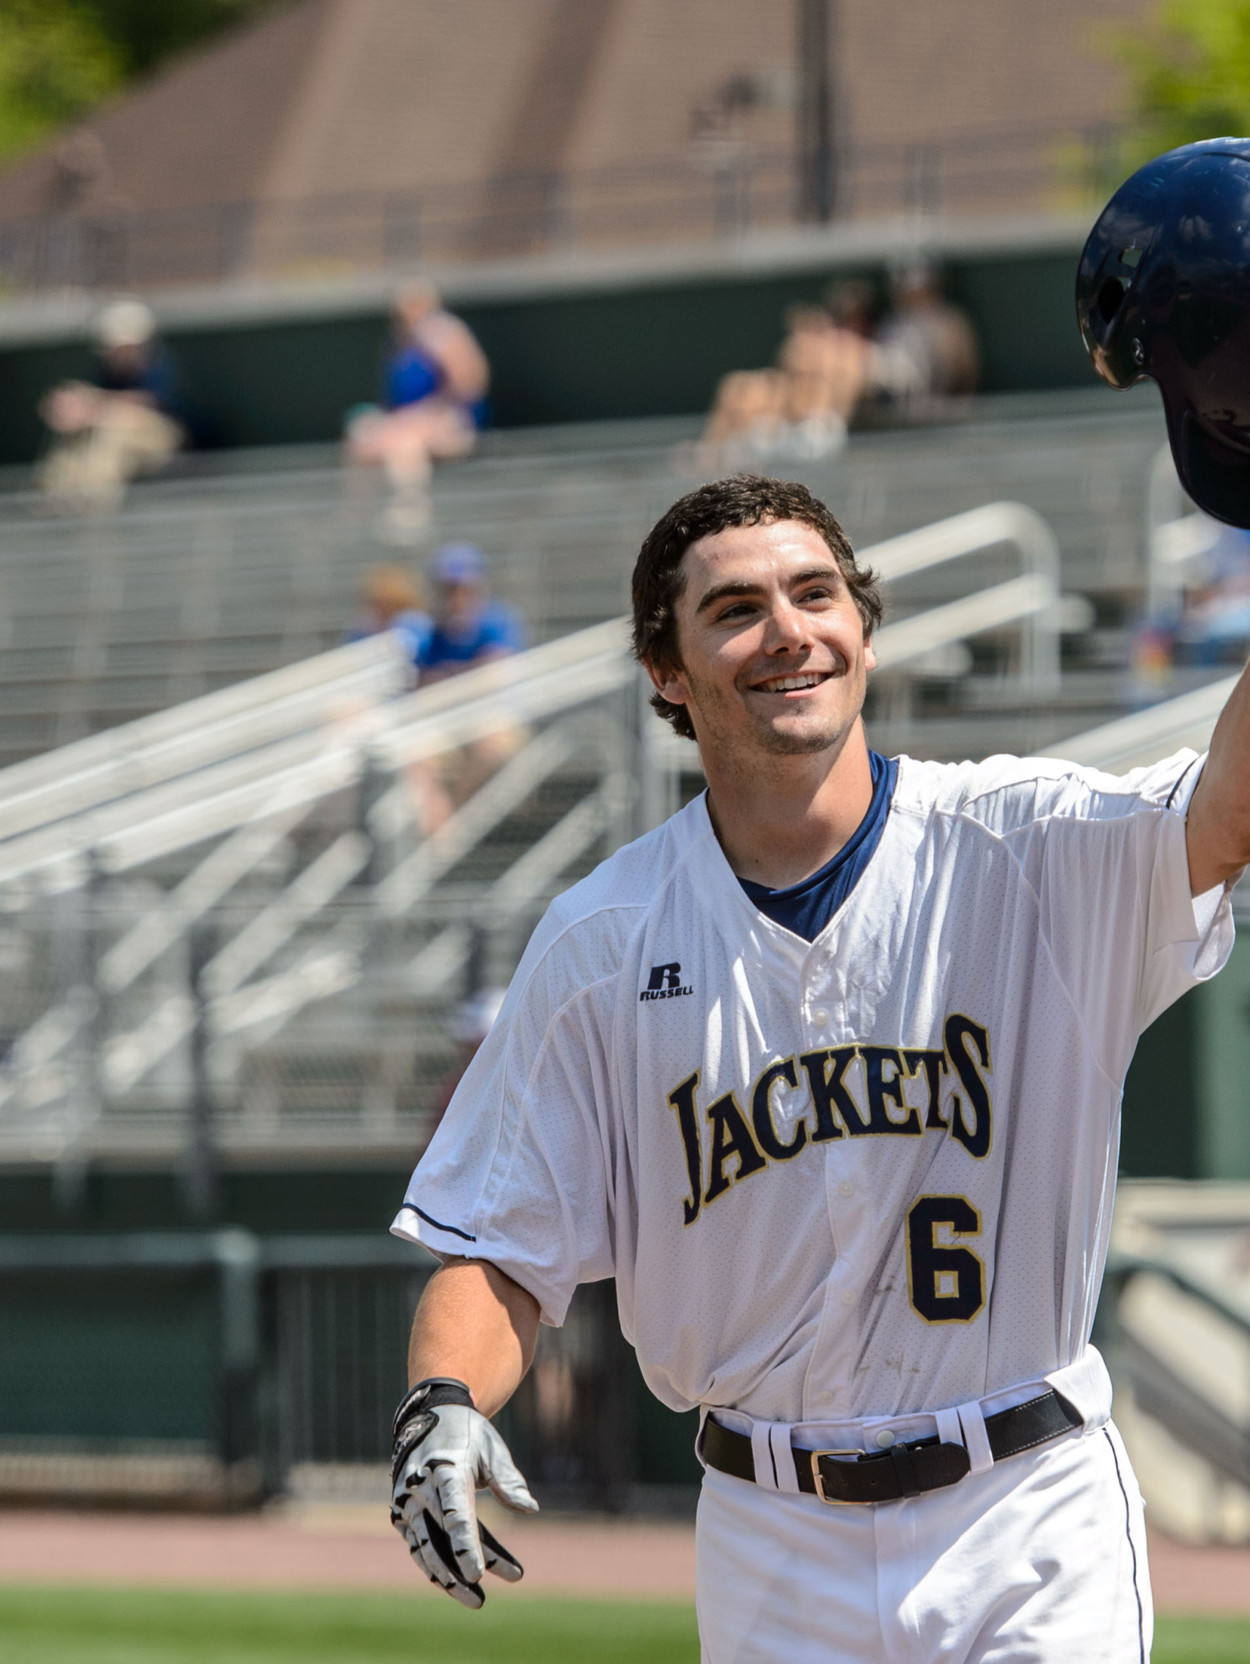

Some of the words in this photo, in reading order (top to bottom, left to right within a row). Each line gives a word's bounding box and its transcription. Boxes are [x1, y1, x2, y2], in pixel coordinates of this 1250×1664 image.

[639, 985, 694, 1002] RUSSELL
[668, 1012, 993, 1228] JACKETS
[906, 1194, 986, 1326] 6
